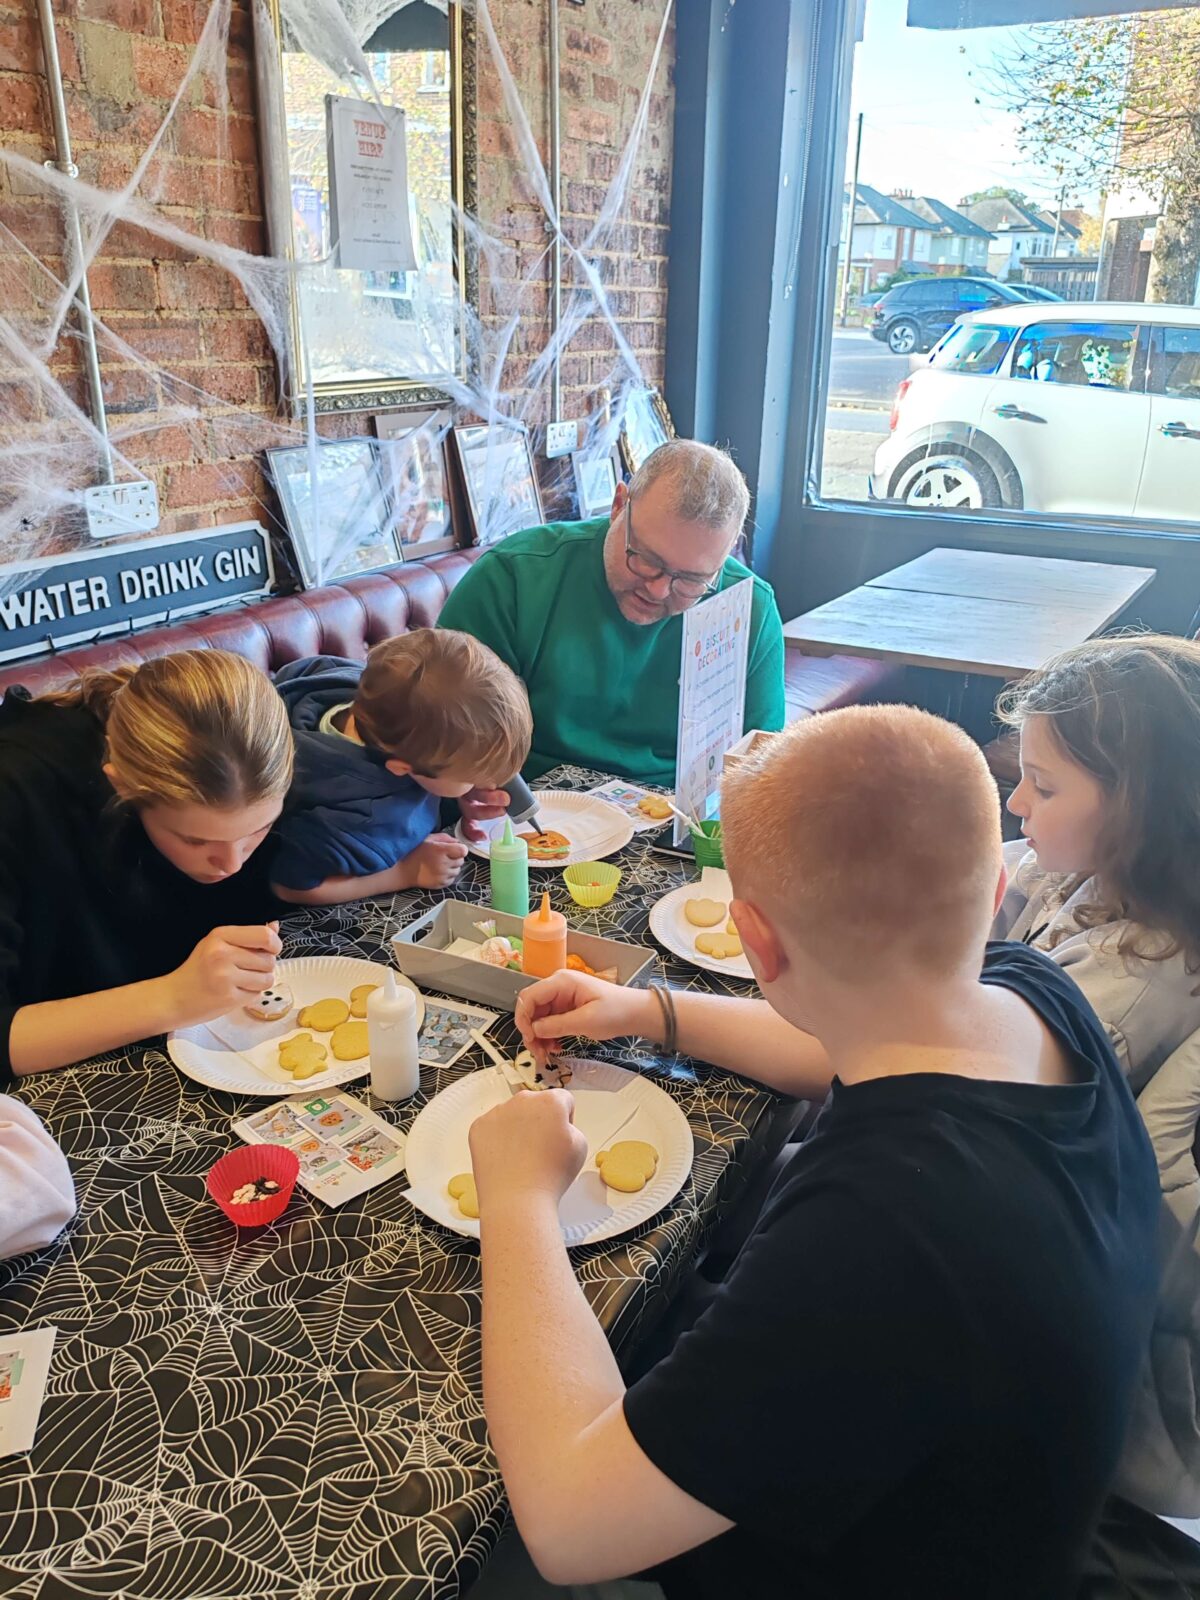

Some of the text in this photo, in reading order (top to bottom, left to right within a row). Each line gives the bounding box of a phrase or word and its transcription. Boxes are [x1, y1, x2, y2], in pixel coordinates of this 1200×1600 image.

[0, 545, 262, 631] WATER DRINK GIN
